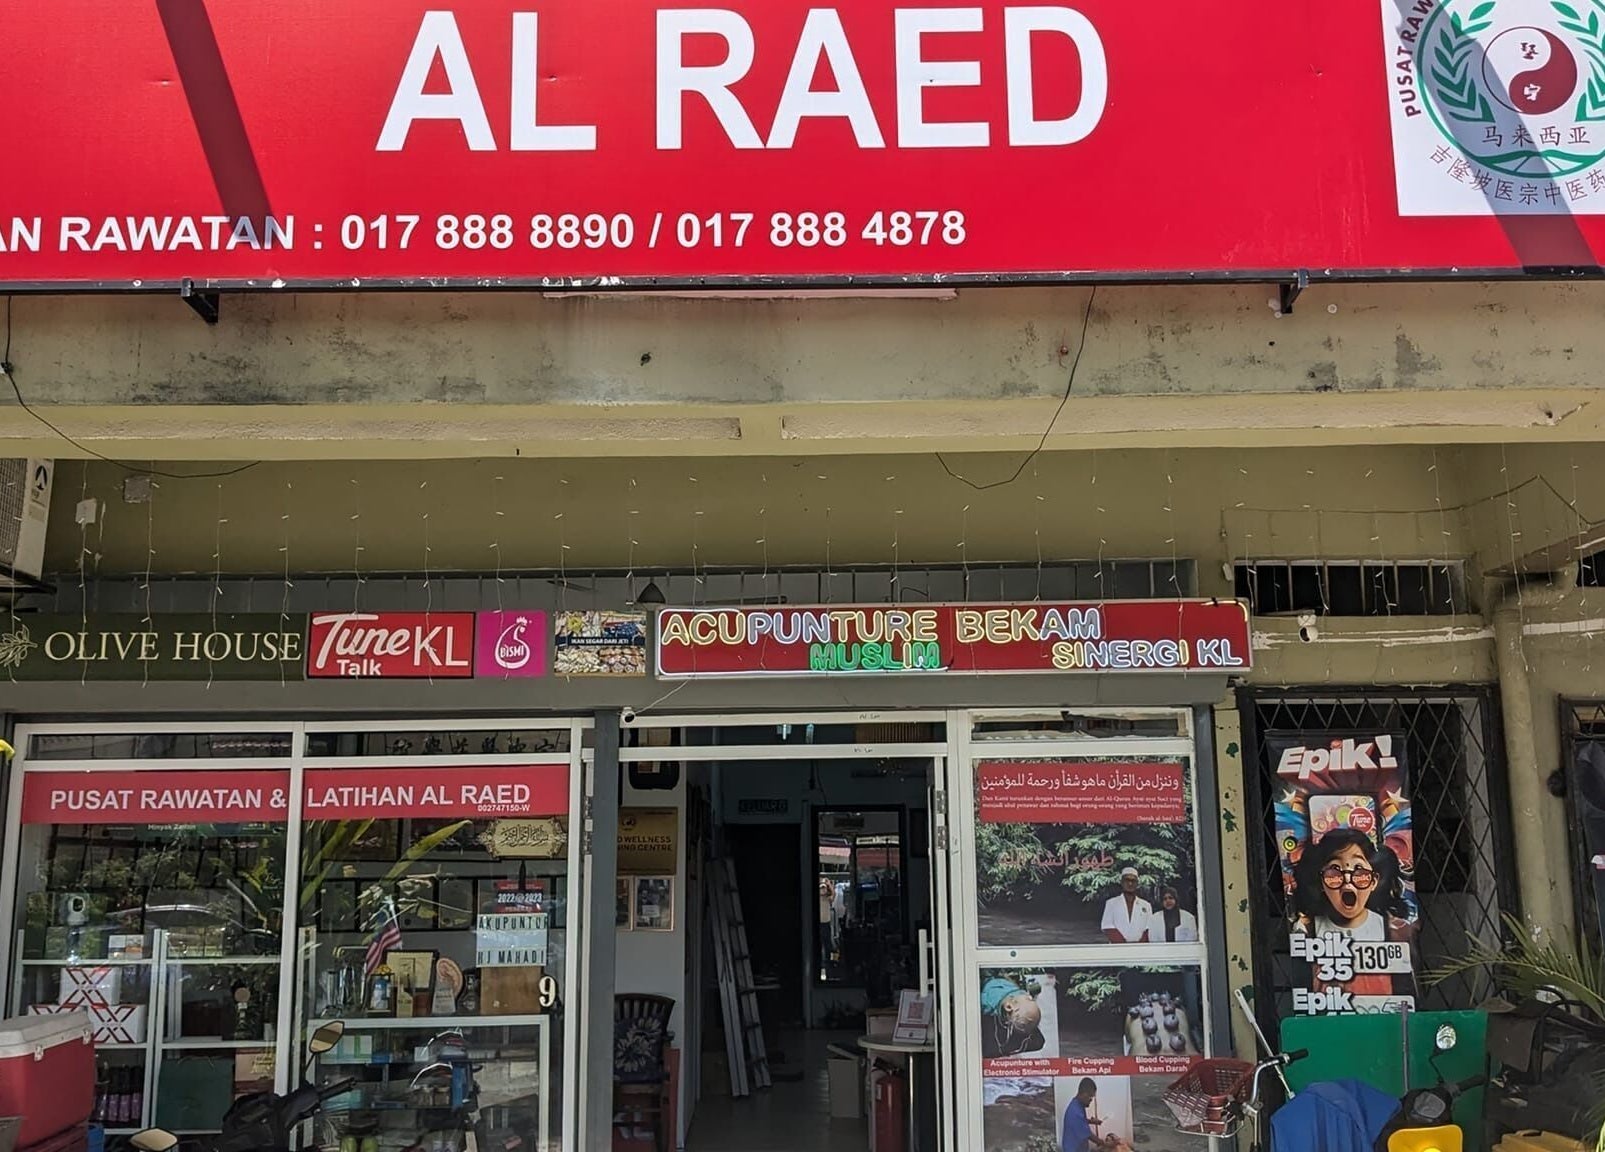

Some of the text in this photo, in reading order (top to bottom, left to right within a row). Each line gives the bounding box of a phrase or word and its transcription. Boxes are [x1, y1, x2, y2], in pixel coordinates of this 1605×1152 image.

[376, 7, 1109, 152] AL RAED
[1396, 46, 1422, 118] PUSAT
[1482, 124, 1591, 148] 马来西亚
[58, 215, 295, 251] RAWATAN
[340, 214, 420, 250] 017
[434, 213, 515, 250] 888
[529, 212, 635, 248] 8890
[675, 212, 754, 248] 017
[769, 211, 847, 247] 888
[861, 210, 966, 246] 4878
[661, 606, 1101, 647] ACUPUNTURE BEKAM
[44, 631, 302, 661] OLIVE HOUSE
[312, 614, 469, 669] Tune KL
[810, 642, 940, 670] MUSLIM
[1051, 638, 1243, 669] SINERGI KL
[336, 658, 382, 677] Talk
[1277, 734, 1398, 780] Epik!
[50, 784, 530, 810] PUSAT RAWATAN & LATIHAN AL RAED
[477, 803, 531, 812] 002747150-W
[1289, 931, 1353, 962] Epik
[1317, 957, 1354, 981] 35
[538, 975, 557, 1008] 9
[1292, 986, 1353, 1015] Epik
[1072, 1066, 1098, 1074] Bekam
[1083, 1057, 1115, 1066] Cupping
[1139, 1065, 1165, 1073] Bekam
[1159, 1056, 1191, 1064] Cupping
